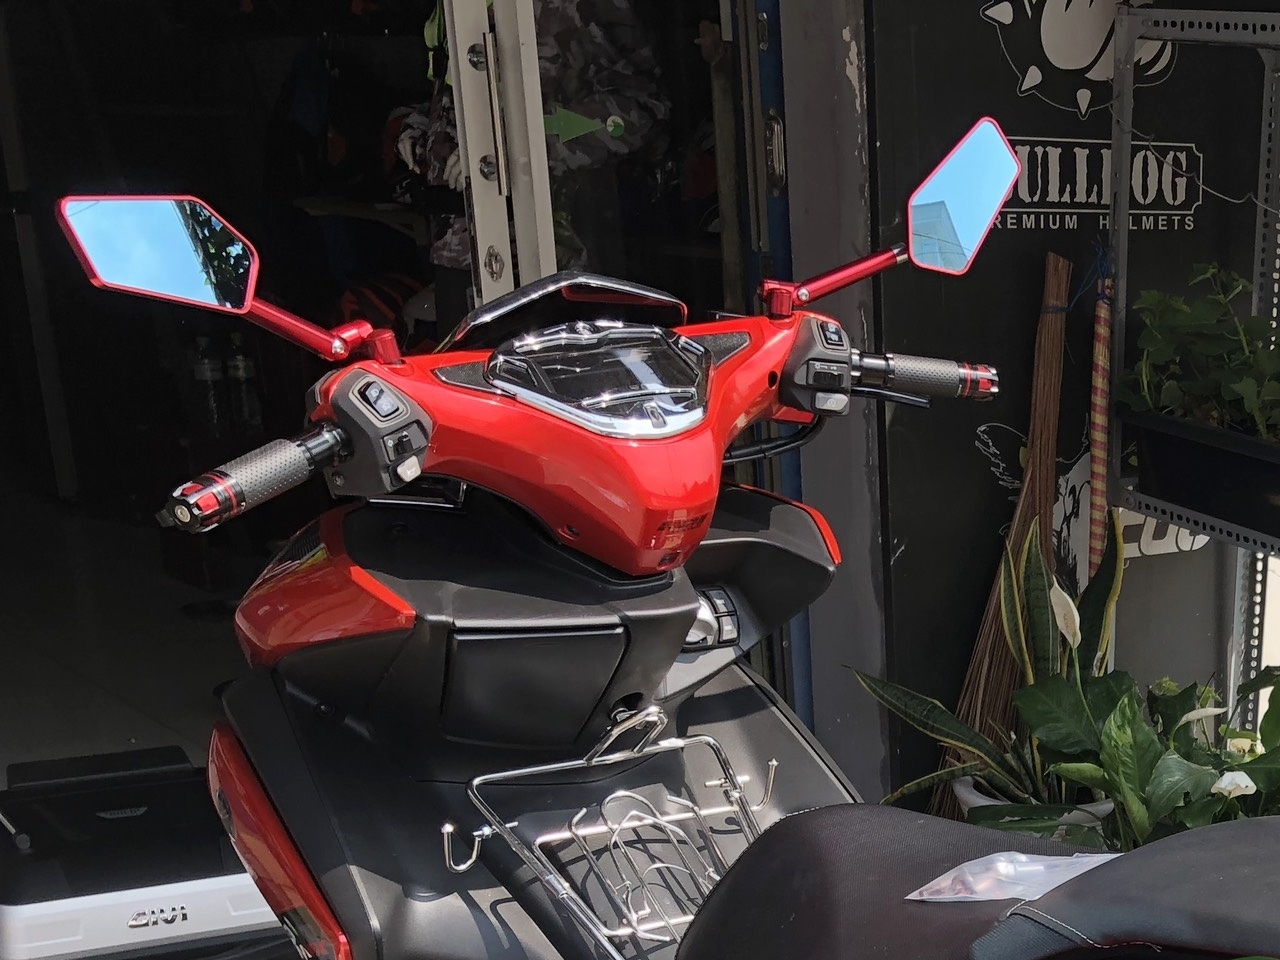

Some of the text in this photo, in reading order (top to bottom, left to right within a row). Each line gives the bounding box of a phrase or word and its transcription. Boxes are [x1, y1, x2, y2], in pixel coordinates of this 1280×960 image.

[1008, 145, 1187, 206] ULLOG
[992, 212, 1194, 231] REMIUM HLMETS
[127, 904, 188, 929] GIVI
